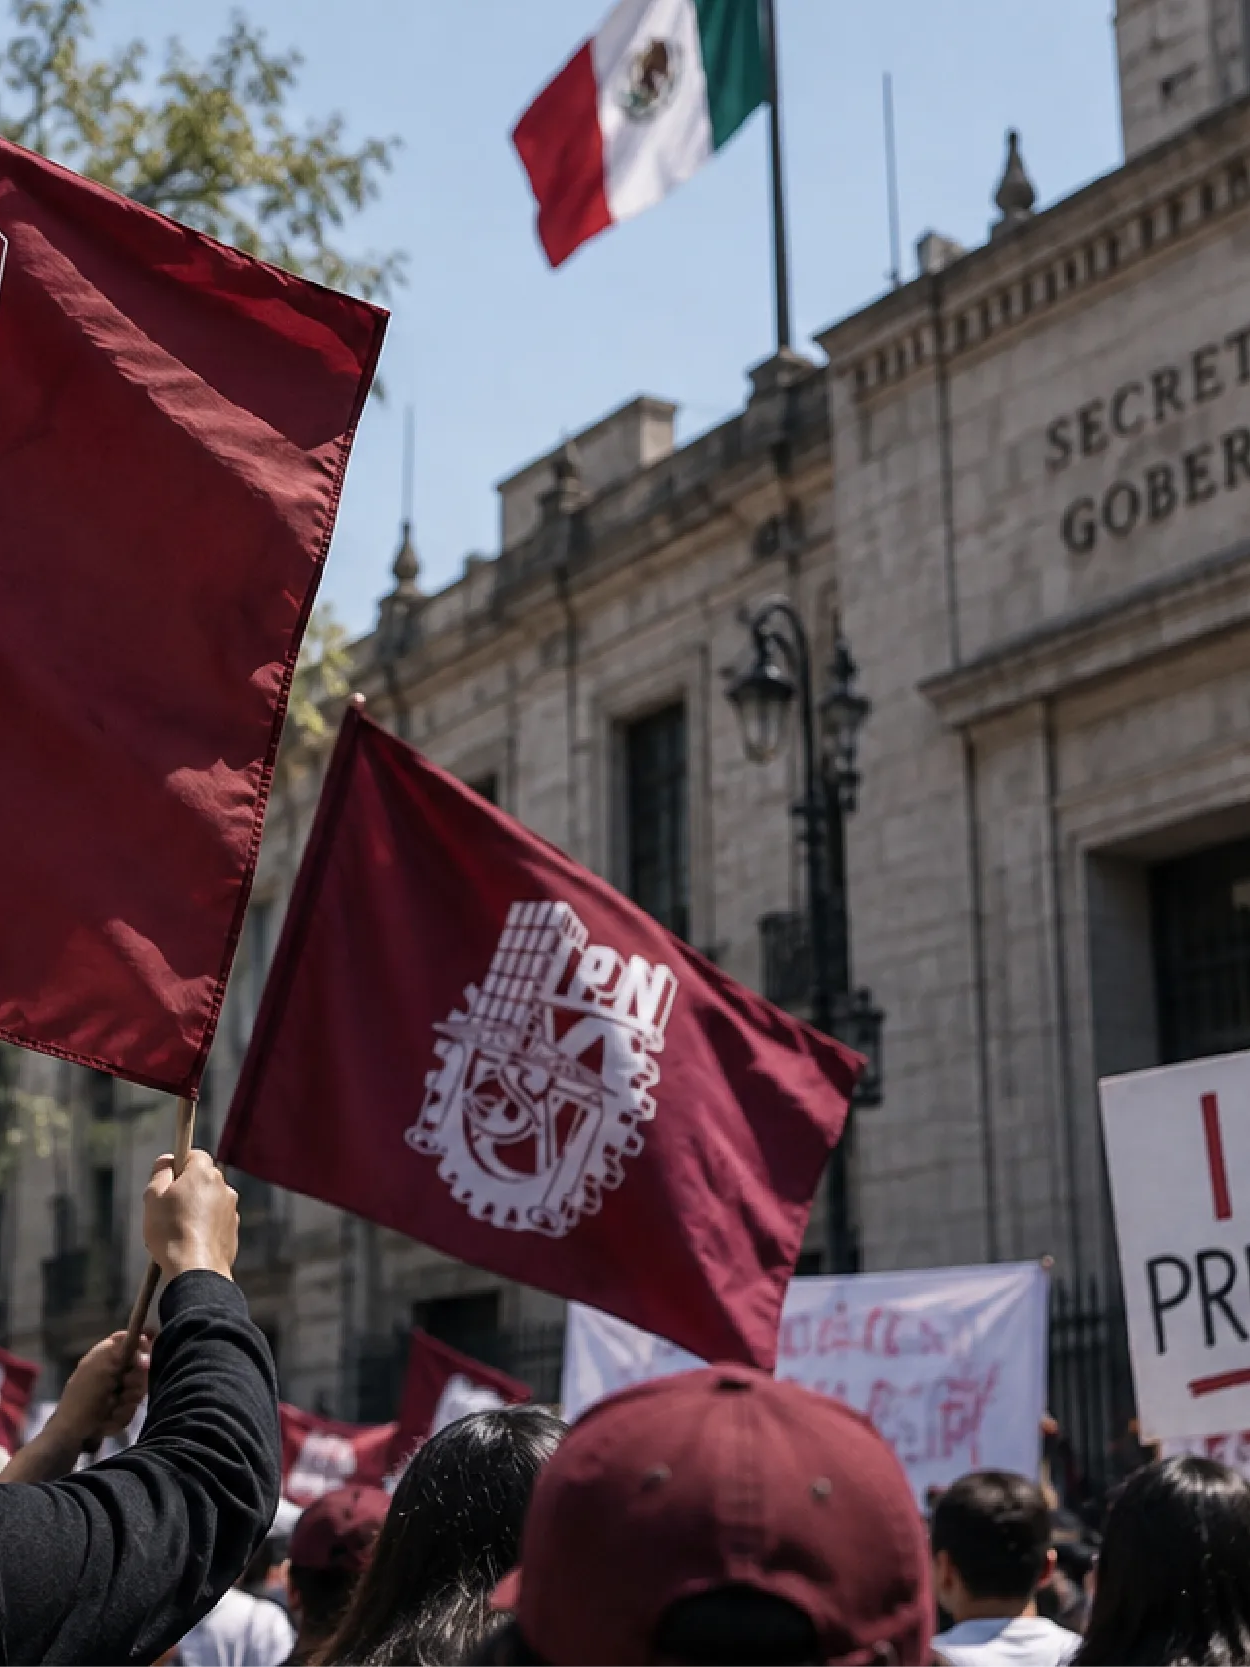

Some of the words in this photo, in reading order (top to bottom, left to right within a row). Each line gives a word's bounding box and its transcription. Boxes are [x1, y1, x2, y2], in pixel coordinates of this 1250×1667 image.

[1046, 328, 1250, 472] SECRET
[1061, 427, 1250, 552] GOBER
[541, 944, 678, 1038] IPN
[1146, 1244, 1250, 1355] PR
